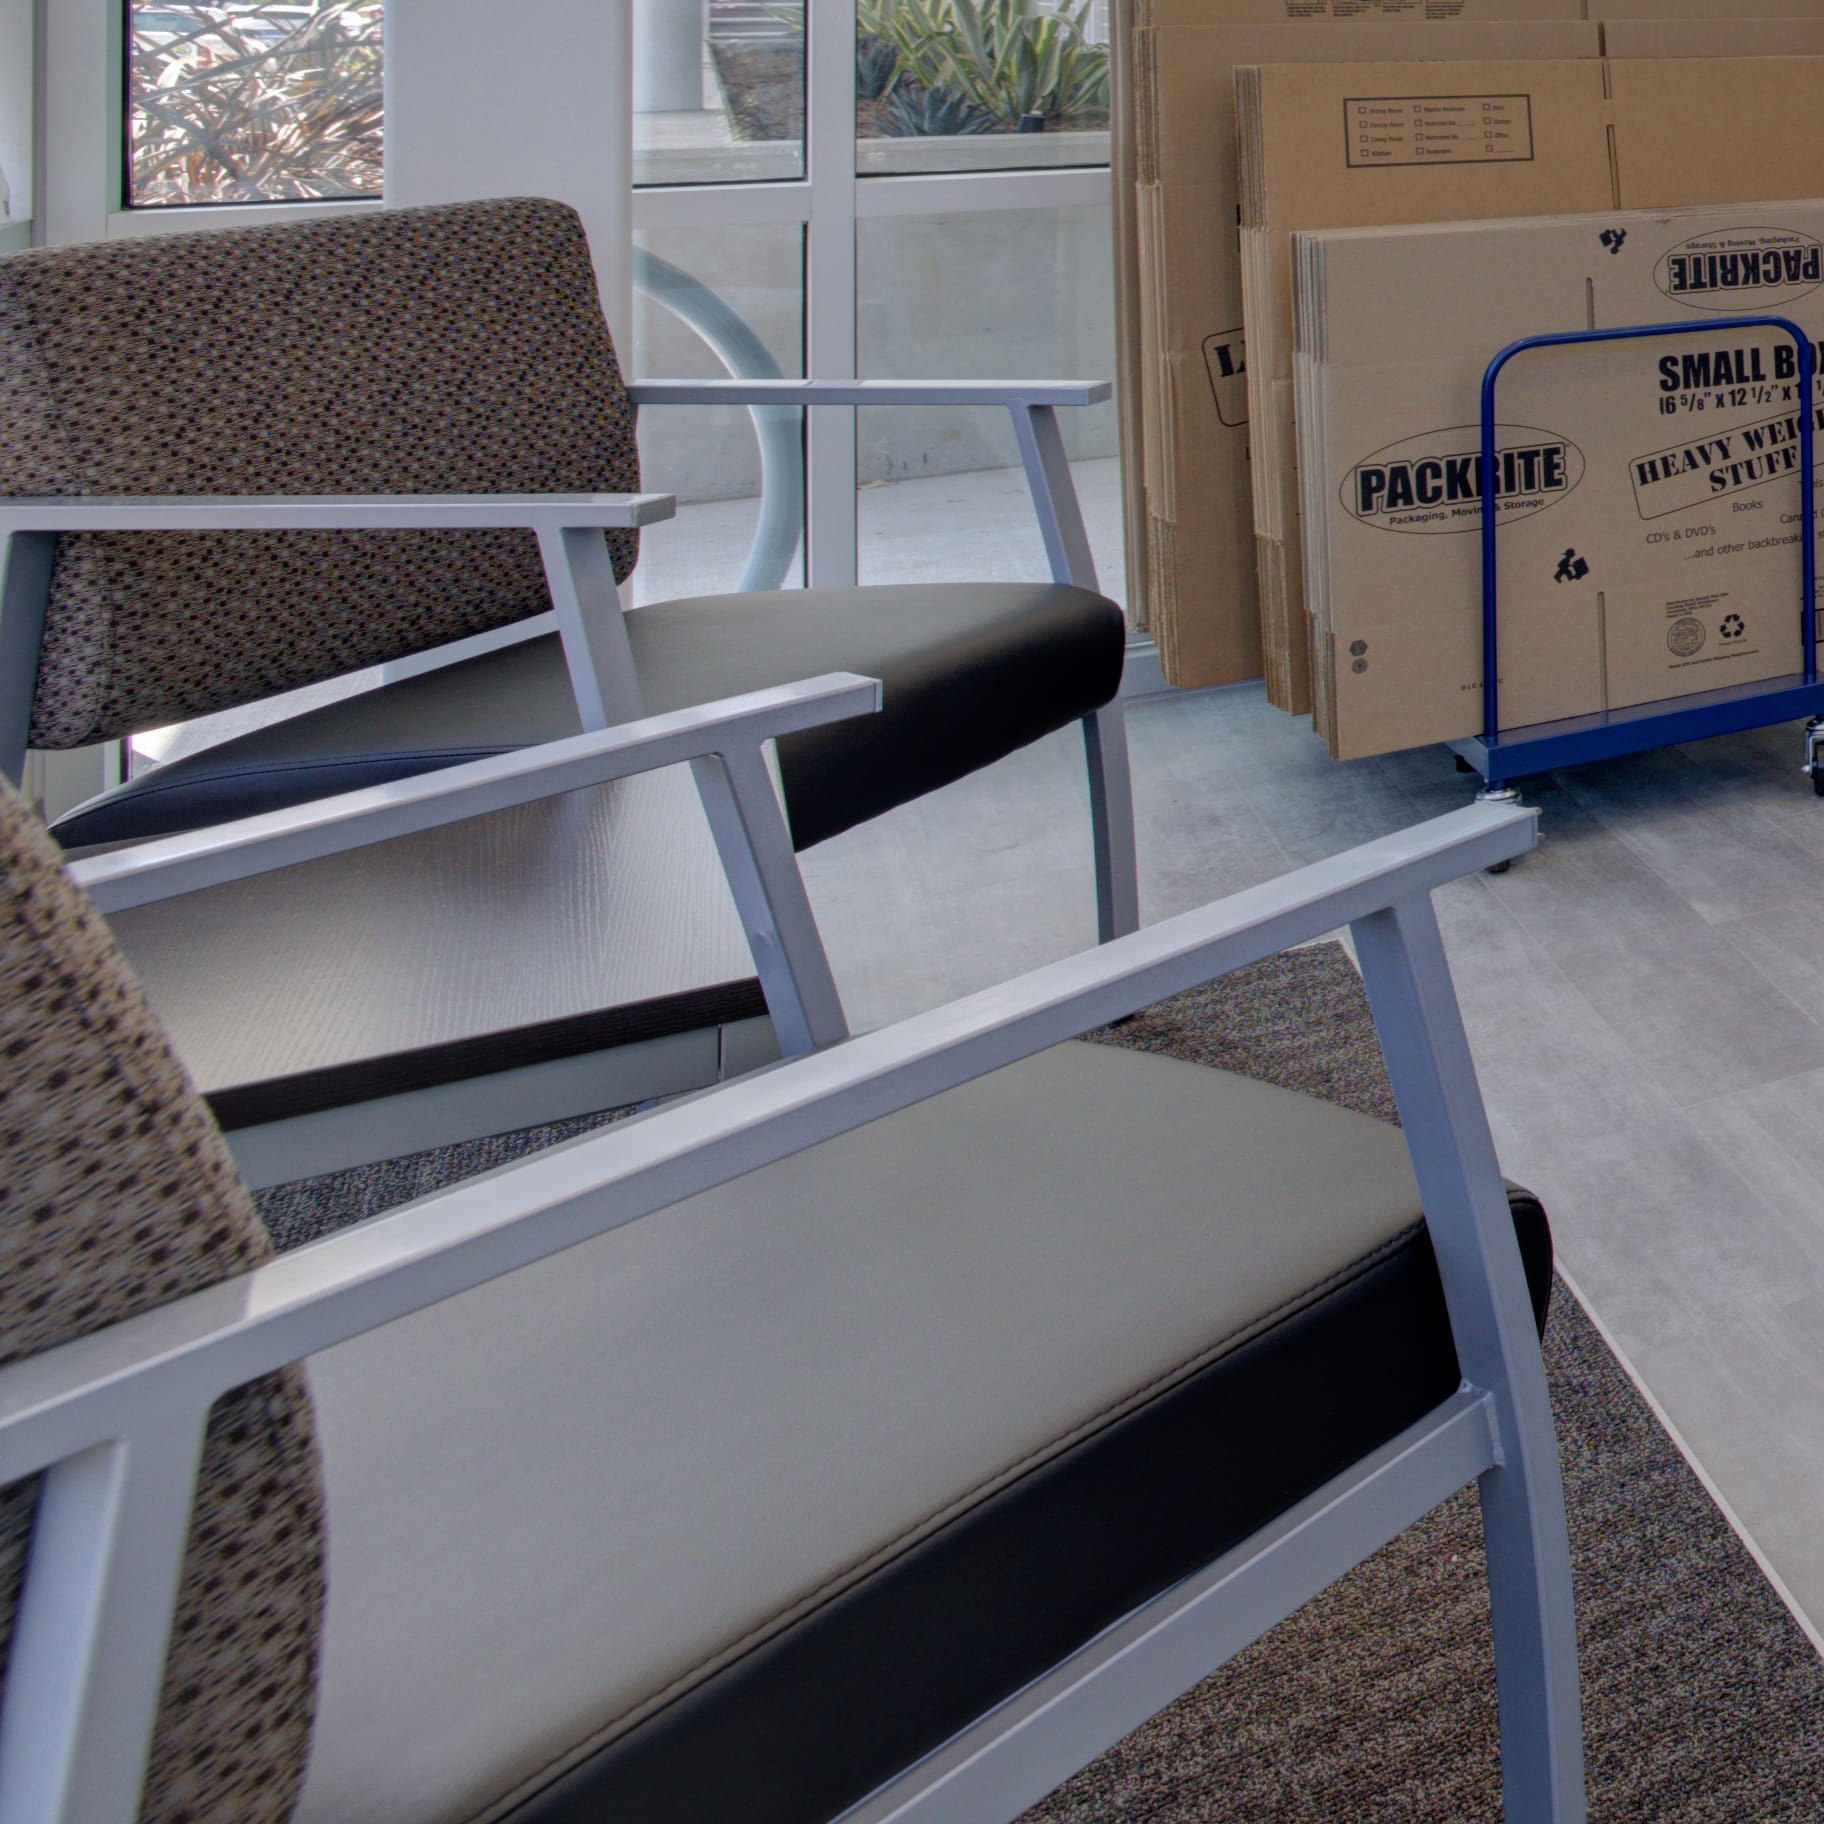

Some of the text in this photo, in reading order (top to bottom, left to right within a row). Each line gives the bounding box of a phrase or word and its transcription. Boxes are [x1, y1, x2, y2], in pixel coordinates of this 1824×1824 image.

[1668, 246, 1822, 293] PACKRITE
[1658, 347, 1767, 392] SMALL
[1727, 388, 1748, 408] 12
[1636, 436, 1732, 486] HEAVY
[1708, 445, 1799, 493] STUFF
[1389, 511, 1448, 525] Packaging,
[1452, 505, 1484, 517] Movin
[1503, 498, 1545, 511] Storage
[1732, 500, 1764, 513] Books
[1779, 507, 1818, 524] Cand
[1646, 525, 1717, 544] CD's & DVD's
[1717, 541, 1745, 555] other
